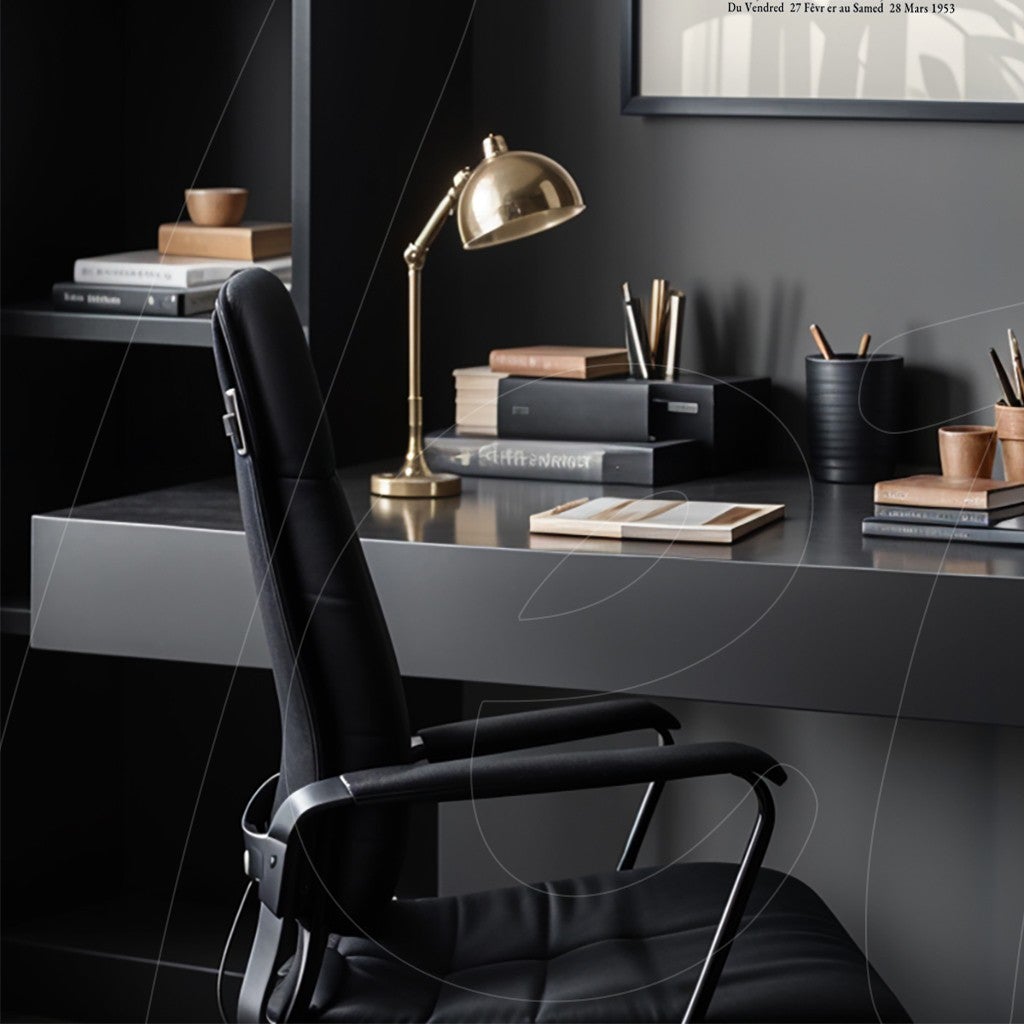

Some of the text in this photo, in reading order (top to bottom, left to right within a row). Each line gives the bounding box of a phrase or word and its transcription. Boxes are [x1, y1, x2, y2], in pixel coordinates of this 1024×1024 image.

[728, 2, 742, 13] Du
[790, 2, 802, 13] 27
[839, 5, 850, 13] au
[889, 3, 901, 14] 28
[904, 3, 929, 14] Mars
[931, 3, 955, 15] 1953
